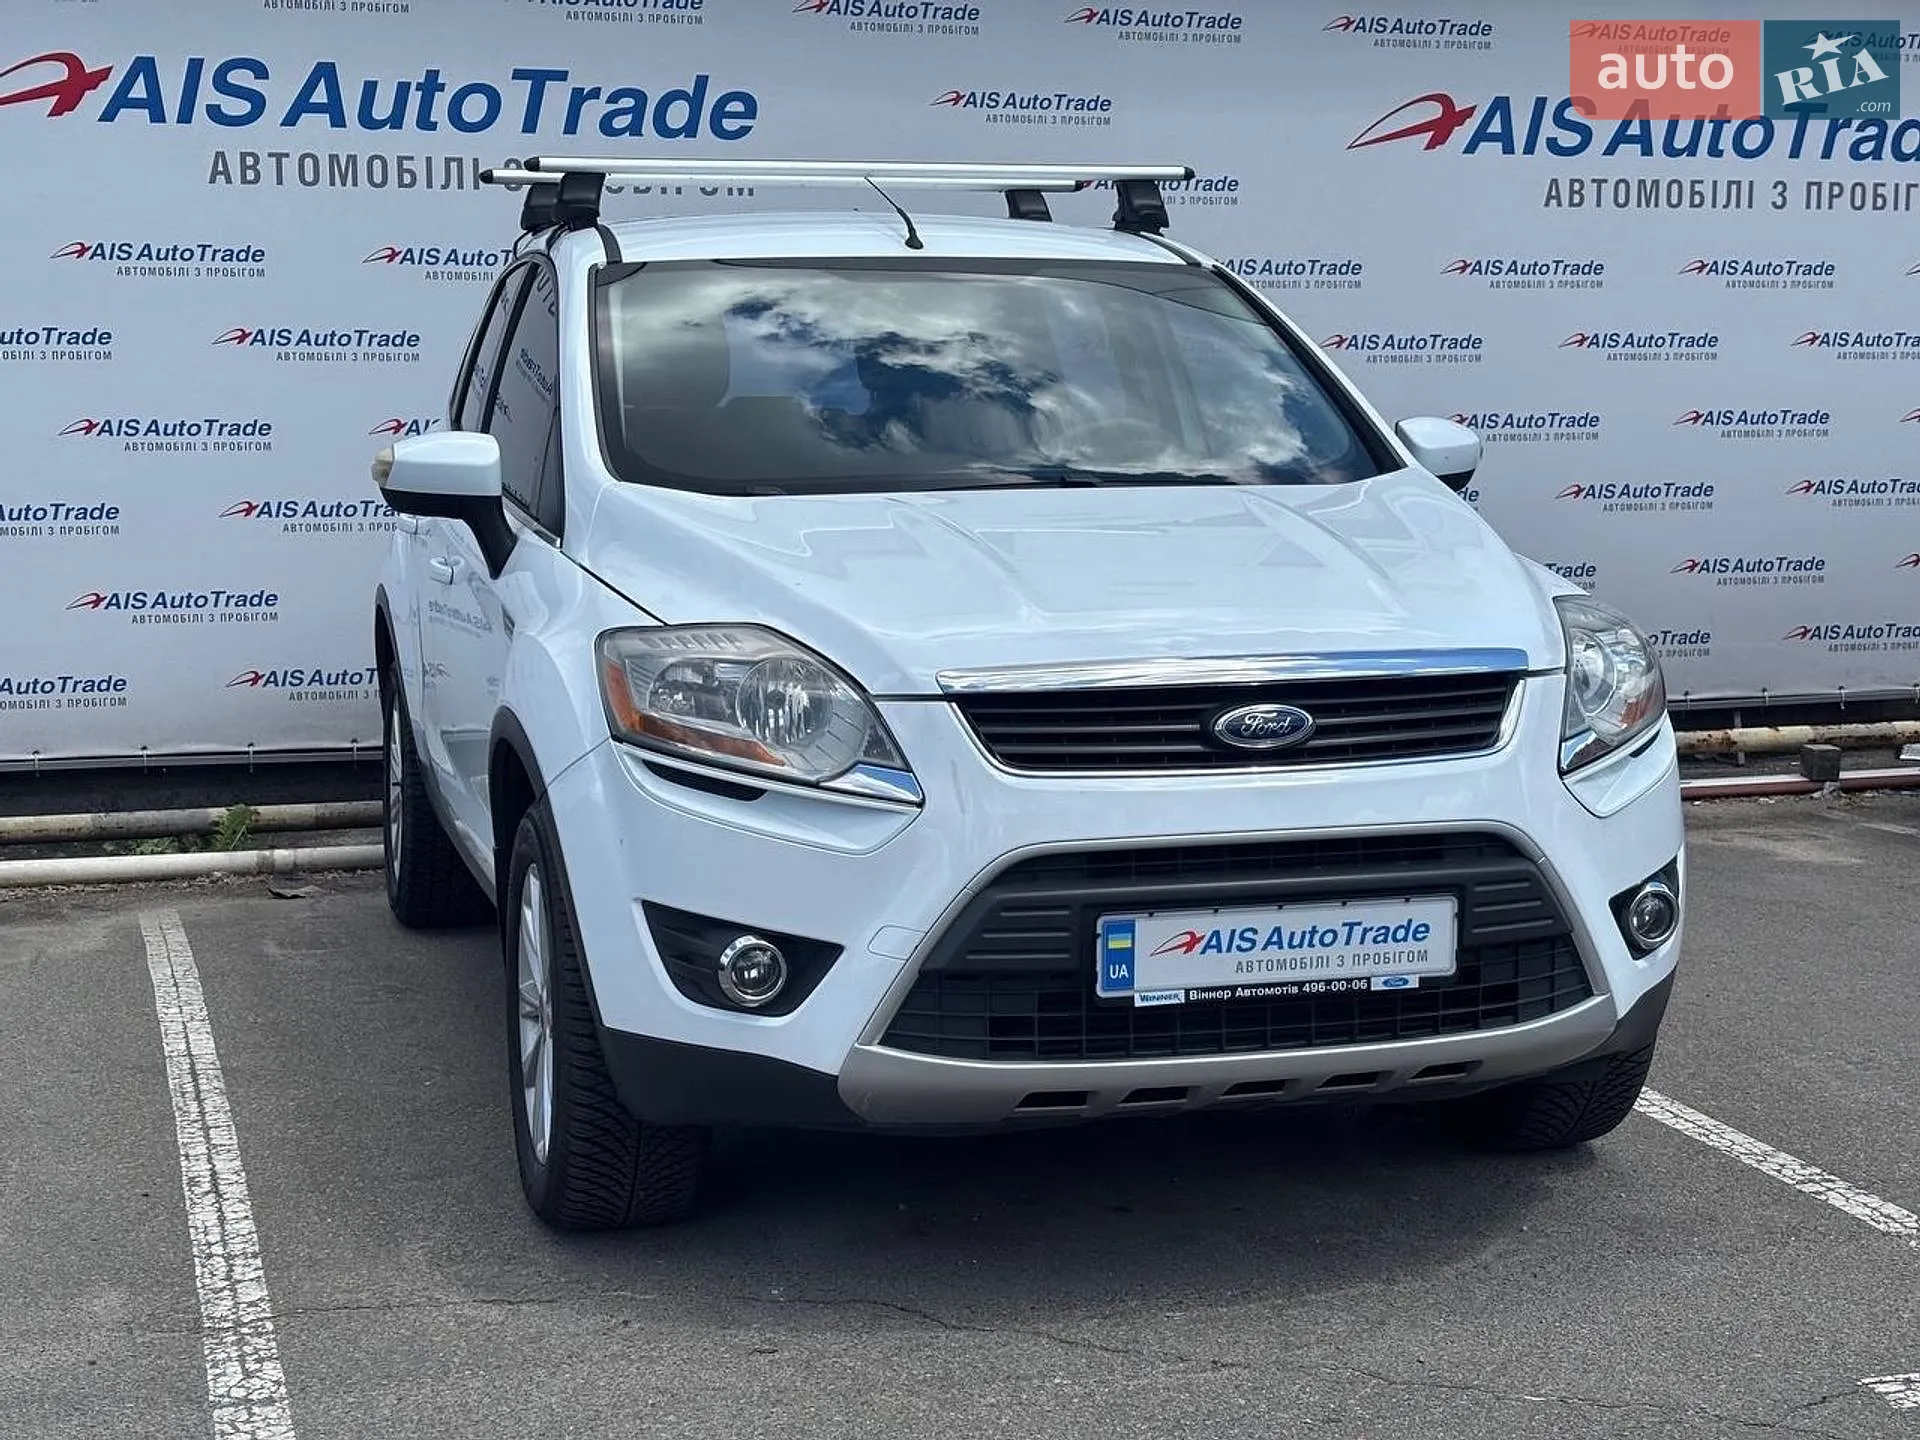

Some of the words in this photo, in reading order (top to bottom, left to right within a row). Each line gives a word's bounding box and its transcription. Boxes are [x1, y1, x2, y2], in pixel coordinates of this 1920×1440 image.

[340, 1, 346, 11] З
[352, 2, 408, 13] ПРОБІГОМ
[826, 0, 864, 16] AIS
[867, 1, 979, 20] AutoTrade
[566, 11, 632, 22] АВТОМОБІЛІ
[1095, 9, 1132, 26] AIS
[1139, 11, 1241, 29] AutoTrade
[851, 22, 913, 32] АВТОМОБІЛІ
[1353, 17, 1388, 33] AIS
[1389, 19, 1492, 35] AutoTrade
[1118, 31, 1178, 41] АВТОМОБІЛІ
[1374, 39, 1431, 48] АВТОМОБІЛІ
[95, 57, 269, 127] AIS
[280, 62, 757, 139] AutoTrade
[963, 92, 1000, 108] AIS
[1002, 94, 1111, 111] AutoTrade
[986, 114, 1046, 124] АВТОМОБІЛІ
[1461, 94, 1599, 157] AIS
[1602, 98, 1920, 162] AutoTrad
[208, 150, 480, 191] АВТОМОБІЛІ
[1544, 179, 1754, 208] АВТОМОБІЛІ
[1772, 181, 1787, 209] З
[1806, 182, 1919, 211] ПРОБІГ
[88, 243, 132, 260] AIS
[136, 244, 265, 262] AutoTrade
[399, 248, 440, 265] AIS
[443, 249, 512, 266] AutoT
[117, 267, 189, 276] АВТОМОБІЛІ
[1226, 259, 1257, 275] AIS
[1259, 260, 1362, 275] AutoTrade
[1469, 260, 1503, 275] AIS
[1505, 260, 1604, 275] AutoTrade
[1706, 260, 1739, 275] AIS
[1740, 261, 1835, 275] AutoTrade
[425, 271, 493, 280] АВТОМОБІЛІ
[0, 328, 111, 345] utoTrade
[248, 329, 292, 346] AIS
[295, 330, 419, 347] AutoTrade
[1345, 335, 1380, 350] AIS
[1382, 335, 1482, 350] AutoTrade
[1587, 333, 1619, 348] AIS
[1622, 333, 1718, 348] AutoTrade
[1818, 332, 1849, 347] AIS
[1851, 333, 1920, 347] AutoTra
[3, 351, 34, 360] ОБІЛІ
[276, 352, 346, 361] АВТОМОБІЛІ
[1467, 414, 1499, 429] AIS
[1501, 413, 1599, 428] AutoTrade
[1702, 410, 1734, 425] AIS
[1735, 410, 1829, 425] AutoTrade
[97, 419, 140, 436] AIS
[143, 419, 271, 436] AutoTrade
[125, 442, 196, 451] АВТОМОБІЛІ
[1583, 484, 1616, 499] AIS
[1618, 483, 1713, 498] AutoTrade
[1813, 479, 1844, 494] AIS
[1847, 479, 1920, 494] AutoTra
[256, 501, 298, 518] AIS
[301, 500, 395, 517] AutoTra
[0, 527, 42, 536] МОБІЛІ
[60, 526, 119, 535] ПРОБІГОМ
[283, 523, 352, 532] АВТОМОБІЛІ
[369, 522, 397, 531] ПРОБ
[1698, 558, 1729, 573] AIS
[1732, 557, 1825, 572] AutoTrade
[103, 592, 147, 609] AIS
[150, 591, 278, 608] AutoTrade
[132, 614, 203, 623] АВТОМОБІЛІ
[1649, 630, 1710, 645] oTrade
[1810, 625, 1840, 640] AIS
[1843, 624, 1920, 639] AutoTrad
[0, 677, 127, 694] AutoTrade
[261, 670, 304, 687] AIS
[308, 668, 377, 686] AutoT
[0, 700, 49, 709] ОМОБІЛІ
[68, 697, 126, 707] ПРОБІГОМ
[289, 691, 357, 700] АВТОМОБІЛІ
[1240, 711, 1294, 736] Ford
[1200, 928, 1259, 955] AIS
[1261, 918, 1431, 951] AutoTrade
[1236, 956, 1329, 972] АВТОМОБІЛІ
[1336, 955, 1344, 967] З
[1353, 950, 1427, 965] ПРОБІГОМ
[1109, 965, 1129, 979] UA
[1190, 988, 1231, 1000] Віннер
[1235, 984, 1299, 997] Автомотів
